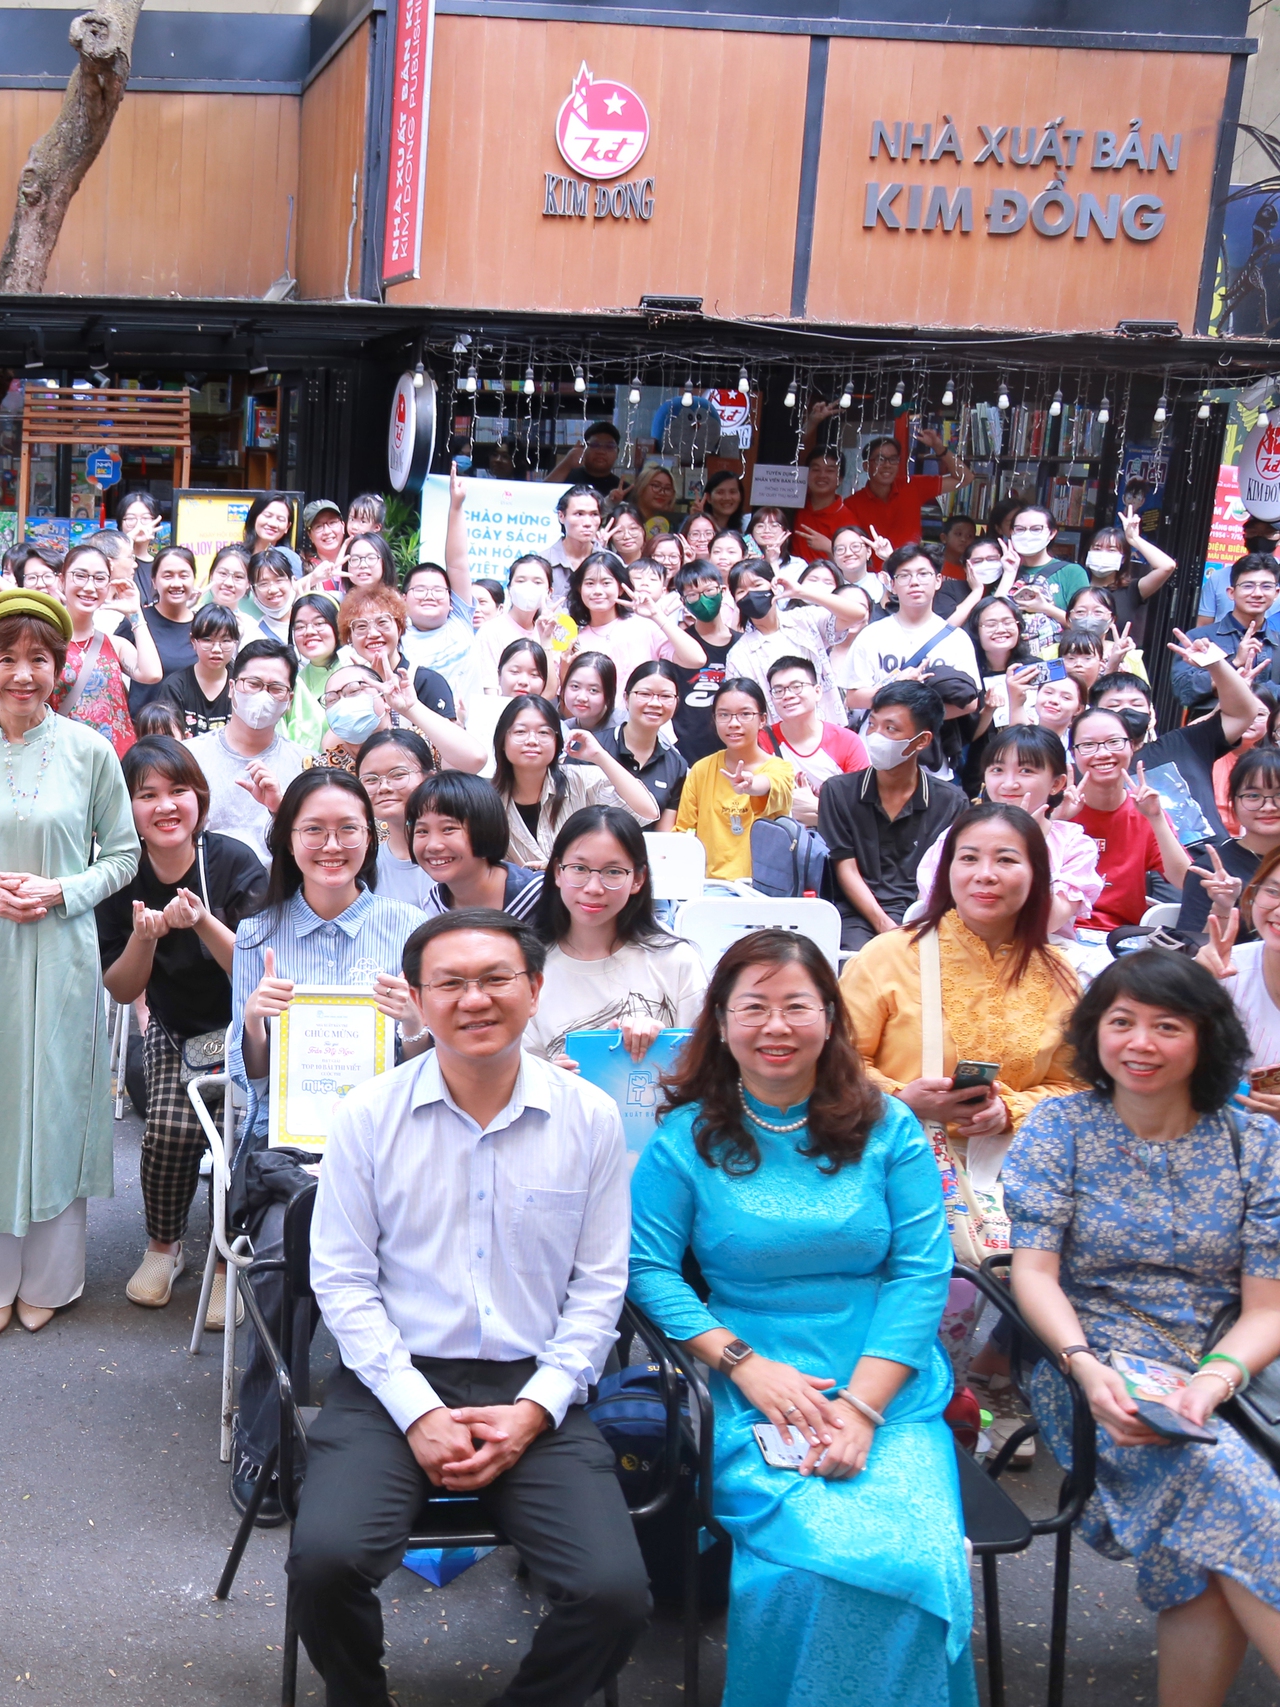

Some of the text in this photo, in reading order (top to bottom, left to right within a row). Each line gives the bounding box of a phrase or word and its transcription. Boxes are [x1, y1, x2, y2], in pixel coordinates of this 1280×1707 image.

[404, 0, 415, 28] KI
[400, 0, 423, 258] KIM DONG PUBLISHI
[869, 114, 1182, 172] NHÀ XUẤT BẢN
[542, 171, 656, 221] KIM ĐỒNG
[862, 170, 1167, 242] KIM ĐỒNG
[1246, 477, 1263, 502] KIM
[507, 510, 551, 527] MỪNG
[467, 527, 548, 544] GÀY SÁCH
[467, 542, 488, 557] ĂN
[304, 1028, 359, 1039] CHÚC MỪNG
[625, 1110, 642, 1118] XUẤT
